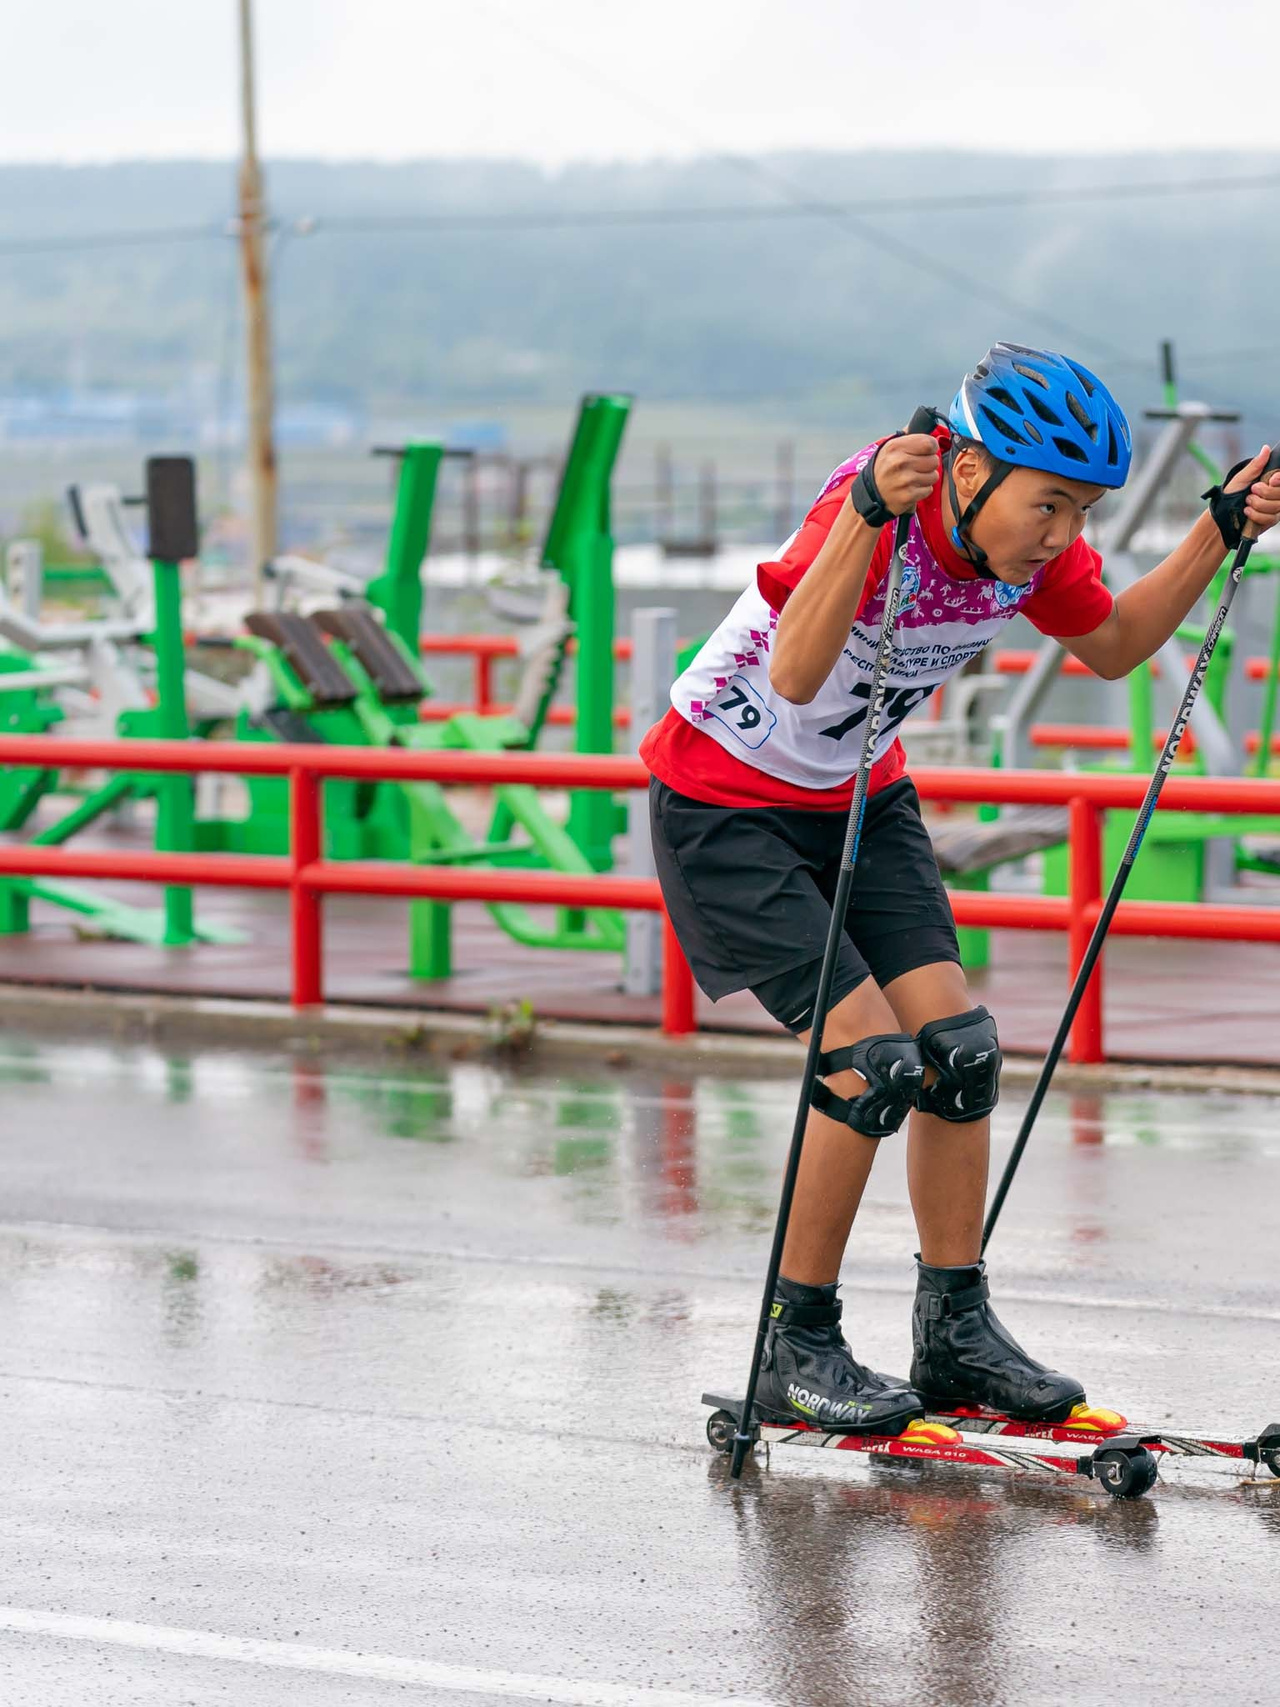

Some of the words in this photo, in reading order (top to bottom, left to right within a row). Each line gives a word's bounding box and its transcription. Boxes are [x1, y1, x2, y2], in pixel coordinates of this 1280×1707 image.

[931, 644, 951, 655] ПО
[941, 651, 979, 665] СПОРТ
[718, 685, 761, 731] 79
[818, 682, 941, 741] 79
[864, 639, 892, 769] NORDWY
[787, 1383, 871, 1424] NORDWAY
[902, 1446, 941, 1455] WASA
